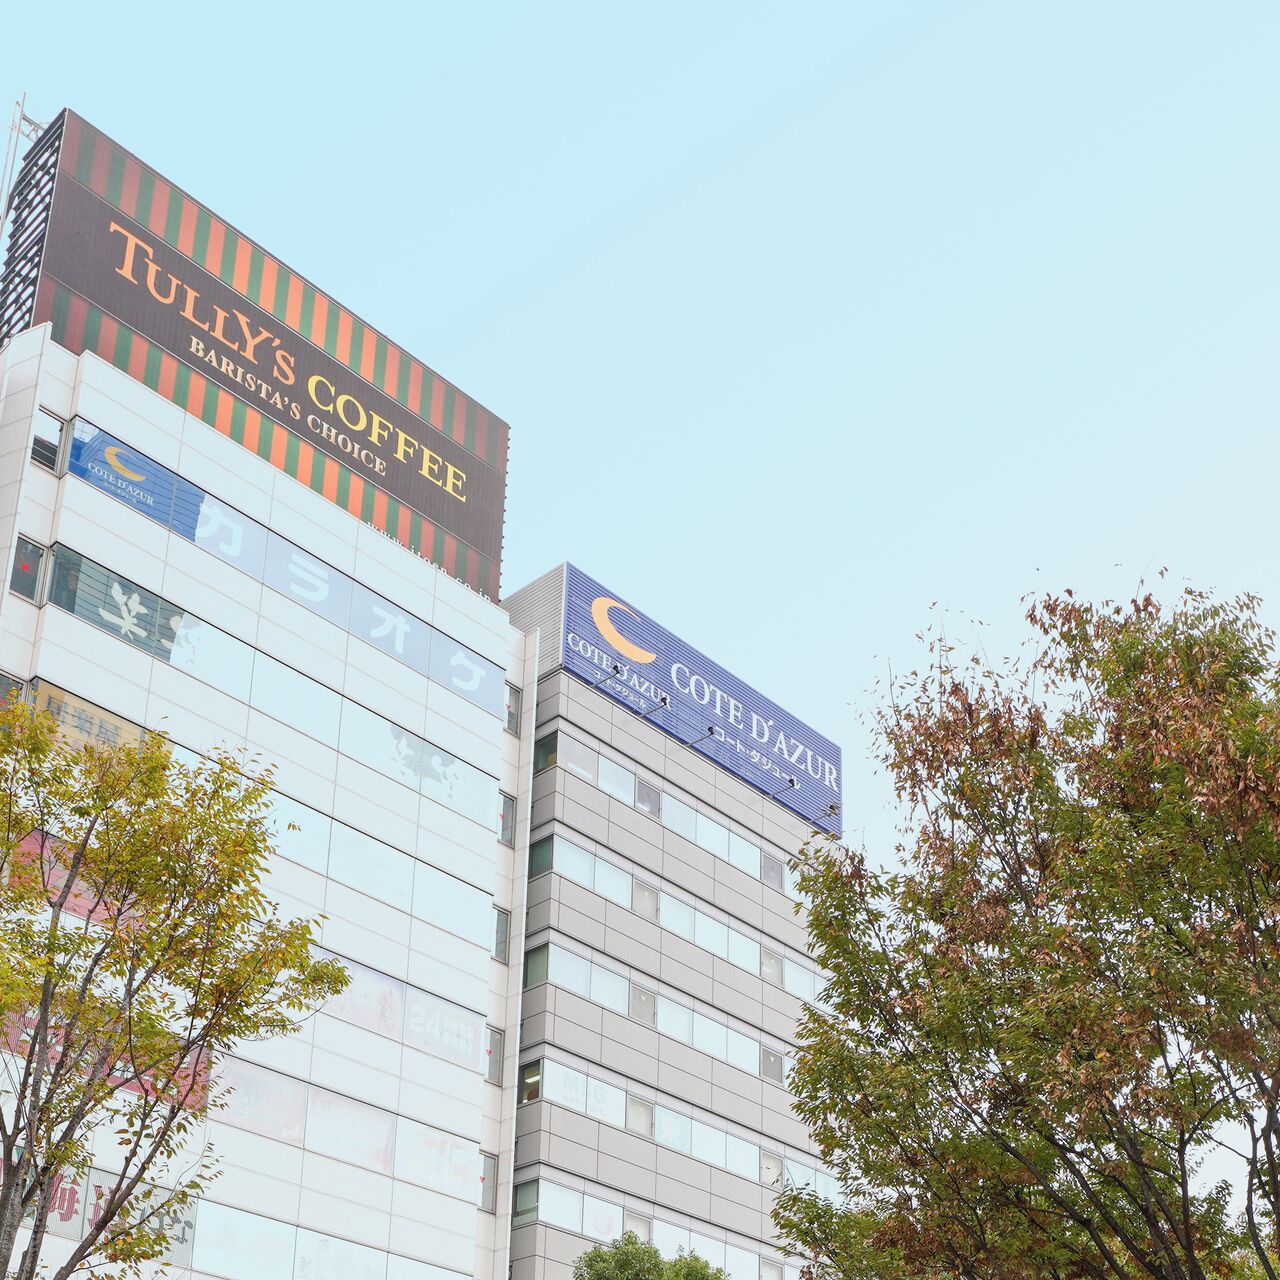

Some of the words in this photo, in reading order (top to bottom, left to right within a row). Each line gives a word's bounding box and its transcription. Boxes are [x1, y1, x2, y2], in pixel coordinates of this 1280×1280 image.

[108, 221, 296, 386] TULLY'S
[307, 373, 467, 503] COFFEE
[188, 335, 301, 421] BARISTA'S
[307, 414, 387, 477] CHOICE
[88, 463, 116, 484] COTE
[195, 502, 487, 691] カラオケ
[568, 632, 612, 672] COTE
[617, 664, 671, 711] D'AZUR
[670, 663, 744, 730] COTE
[750, 710, 839, 793] D'AZUR
